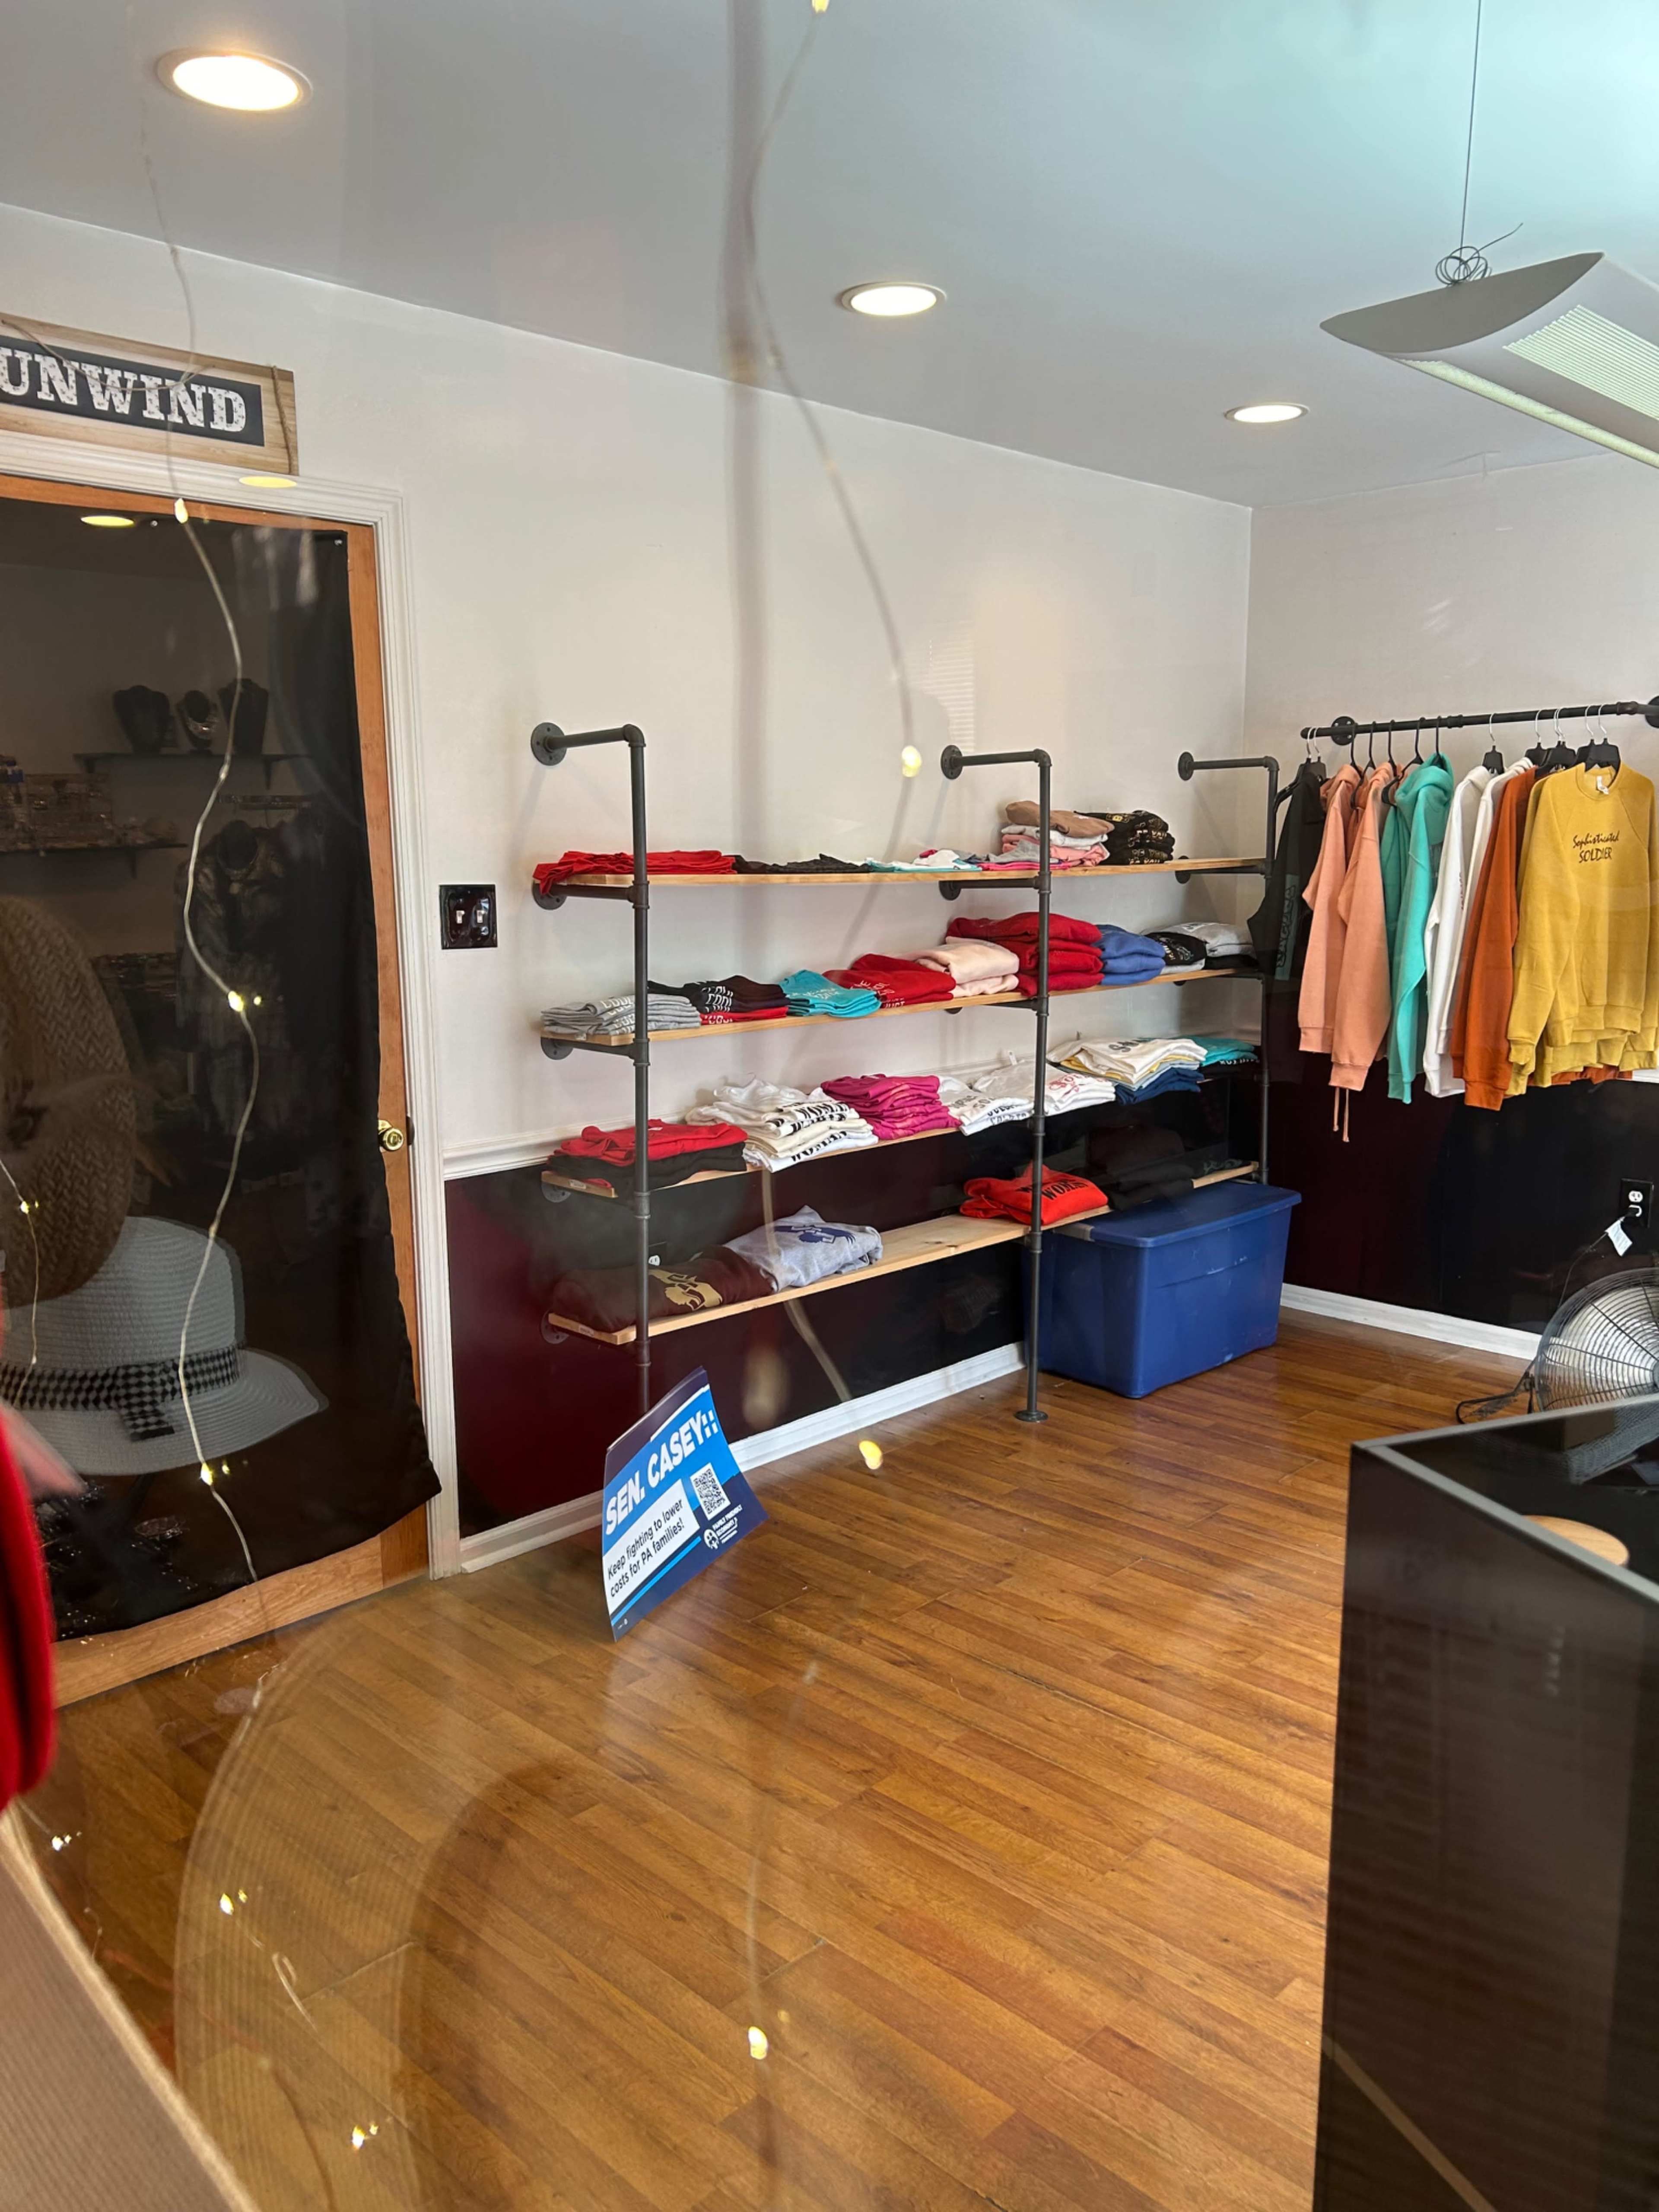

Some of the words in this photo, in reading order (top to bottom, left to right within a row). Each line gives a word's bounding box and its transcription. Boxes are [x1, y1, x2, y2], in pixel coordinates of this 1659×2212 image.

[0, 348, 246, 432] UNWIND
[1573, 830, 1619, 850] Sophisticated
[606, 1470, 645, 1535] SEN.
[607, 1555, 626, 1580] Keep
[626, 1526, 653, 1560] fighting
[653, 1519, 662, 1531] to
[662, 1499, 683, 1523] lower
[610, 1572, 629, 1597] costs
[629, 1560, 641, 1577] for
[641, 1548, 653, 1565] PA
[652, 1517, 685, 1554] families!
